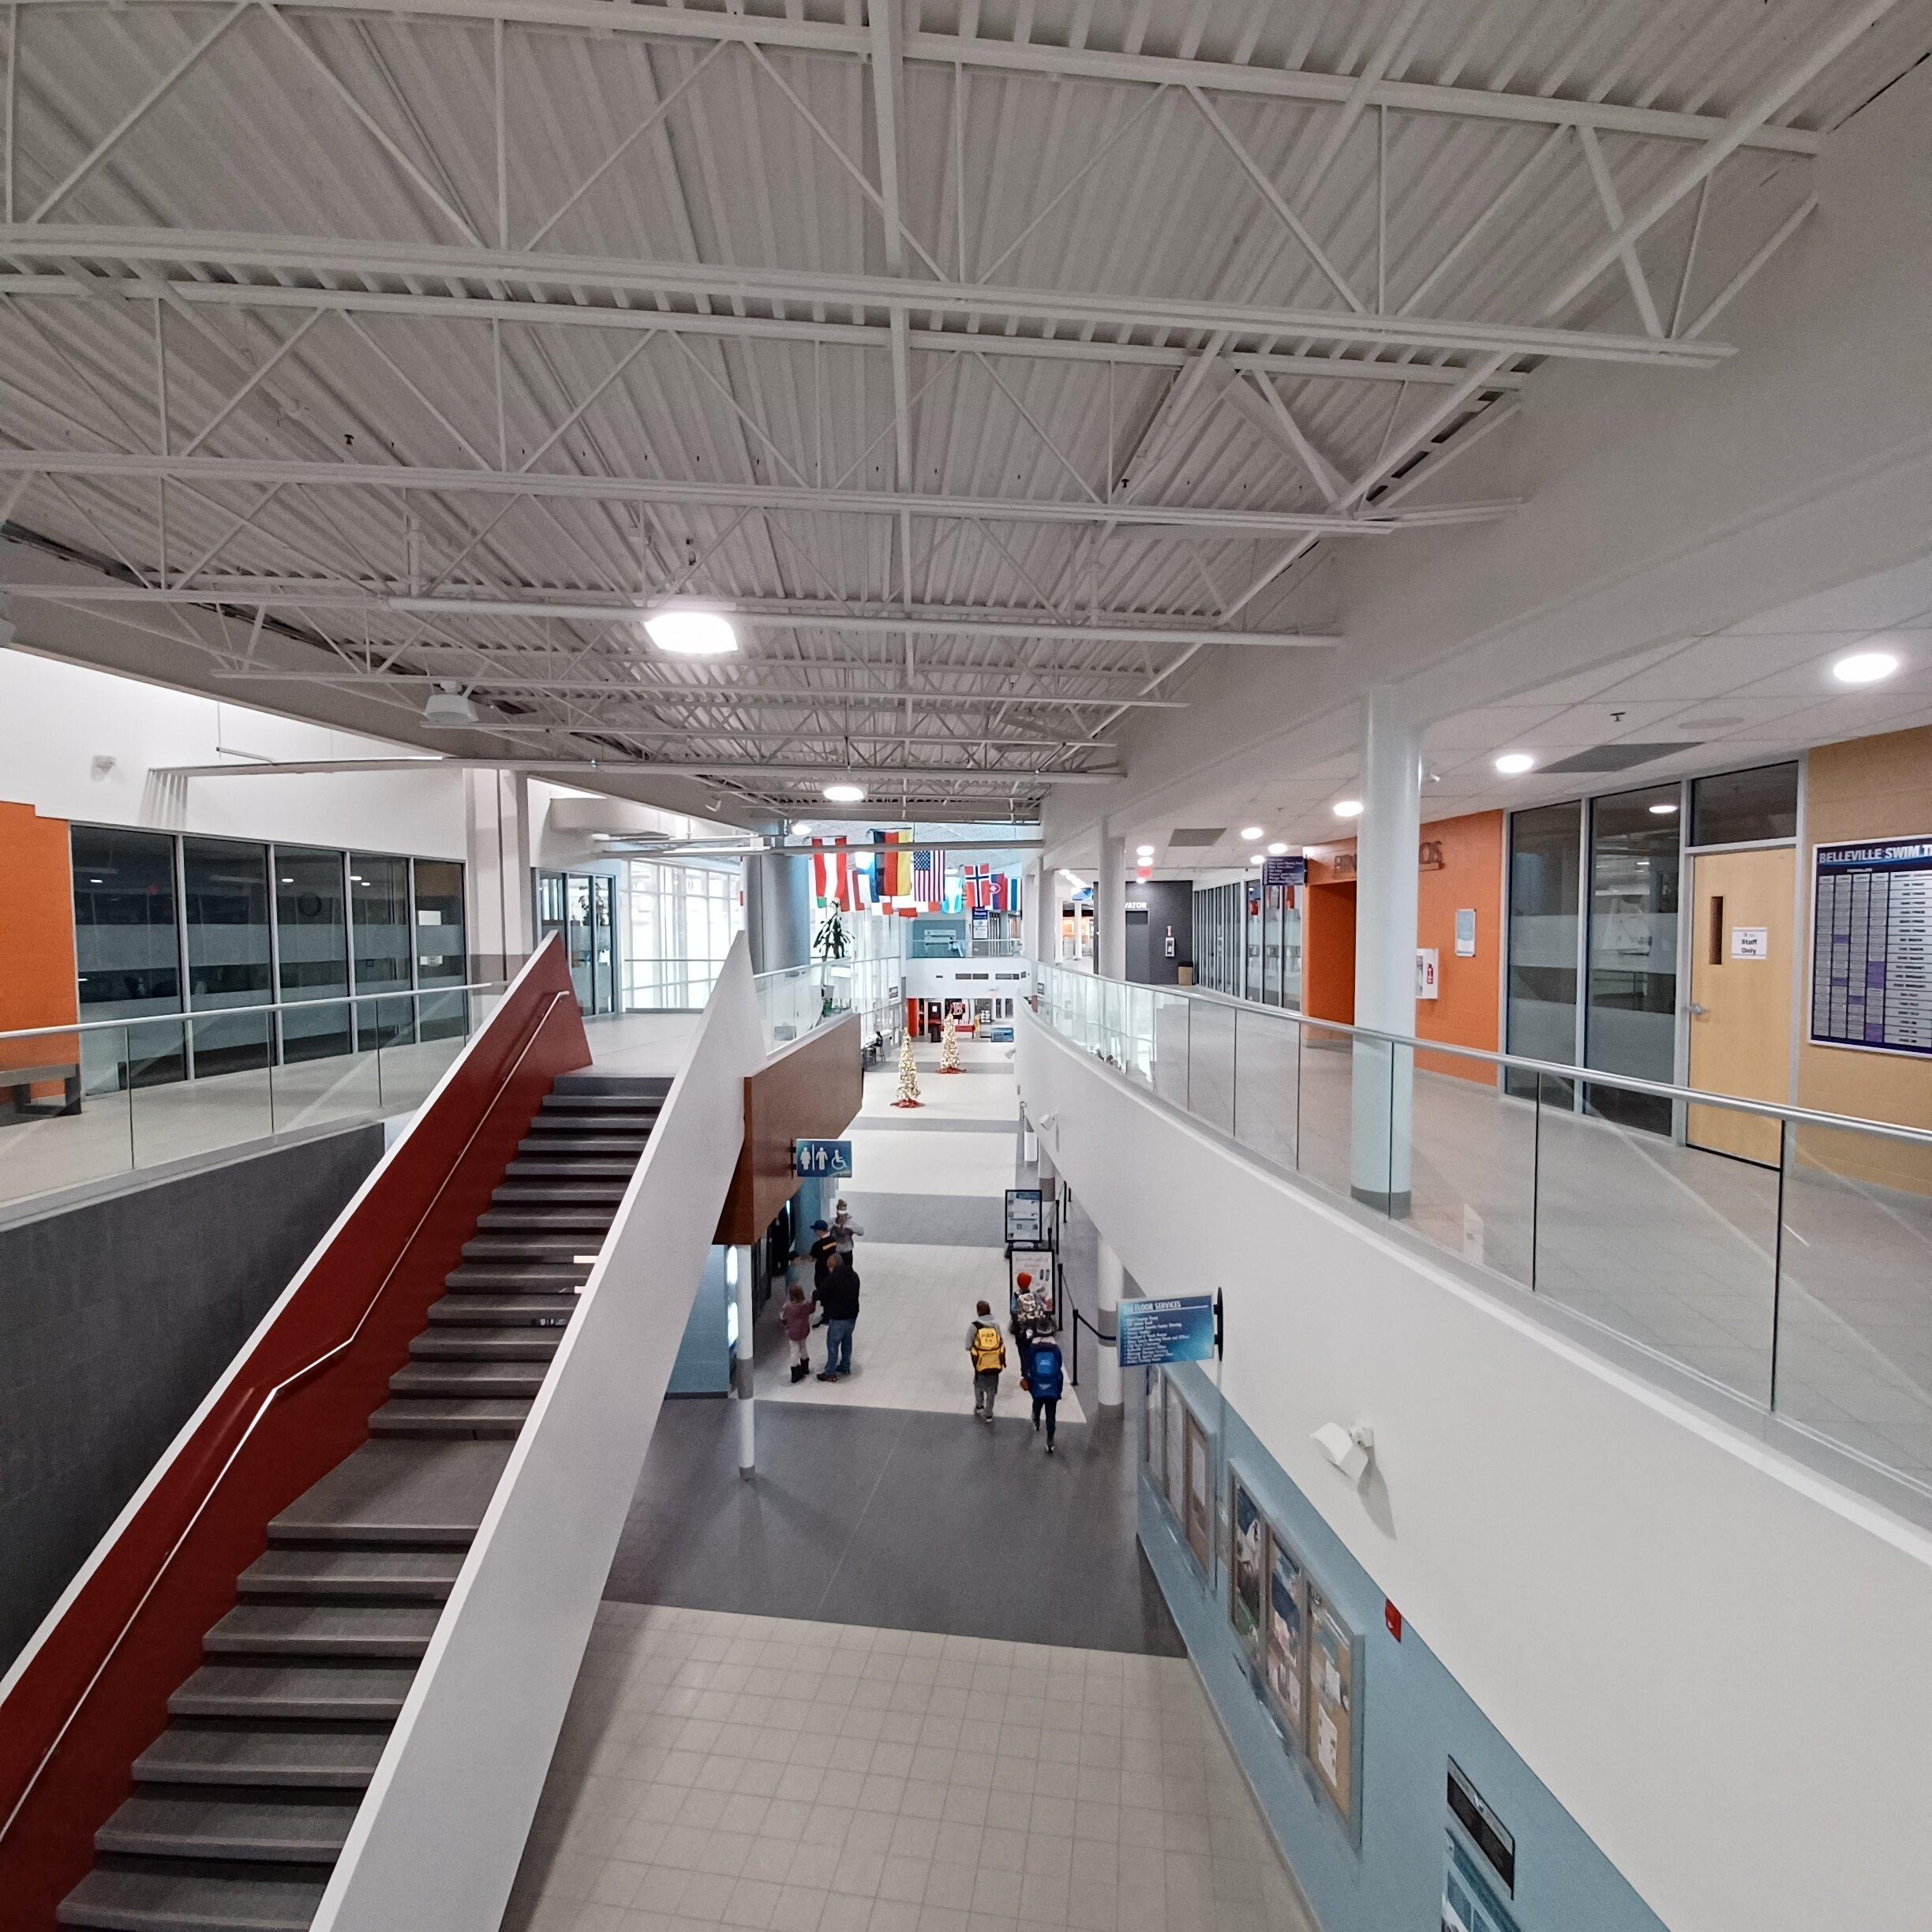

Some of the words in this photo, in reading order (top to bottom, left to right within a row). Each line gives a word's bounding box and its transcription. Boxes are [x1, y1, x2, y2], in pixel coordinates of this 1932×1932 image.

[1818, 848, 1882, 863] BELLEVILLE
[1885, 845, 1920, 859] SWIM
[1741, 947, 1757, 956] Only
